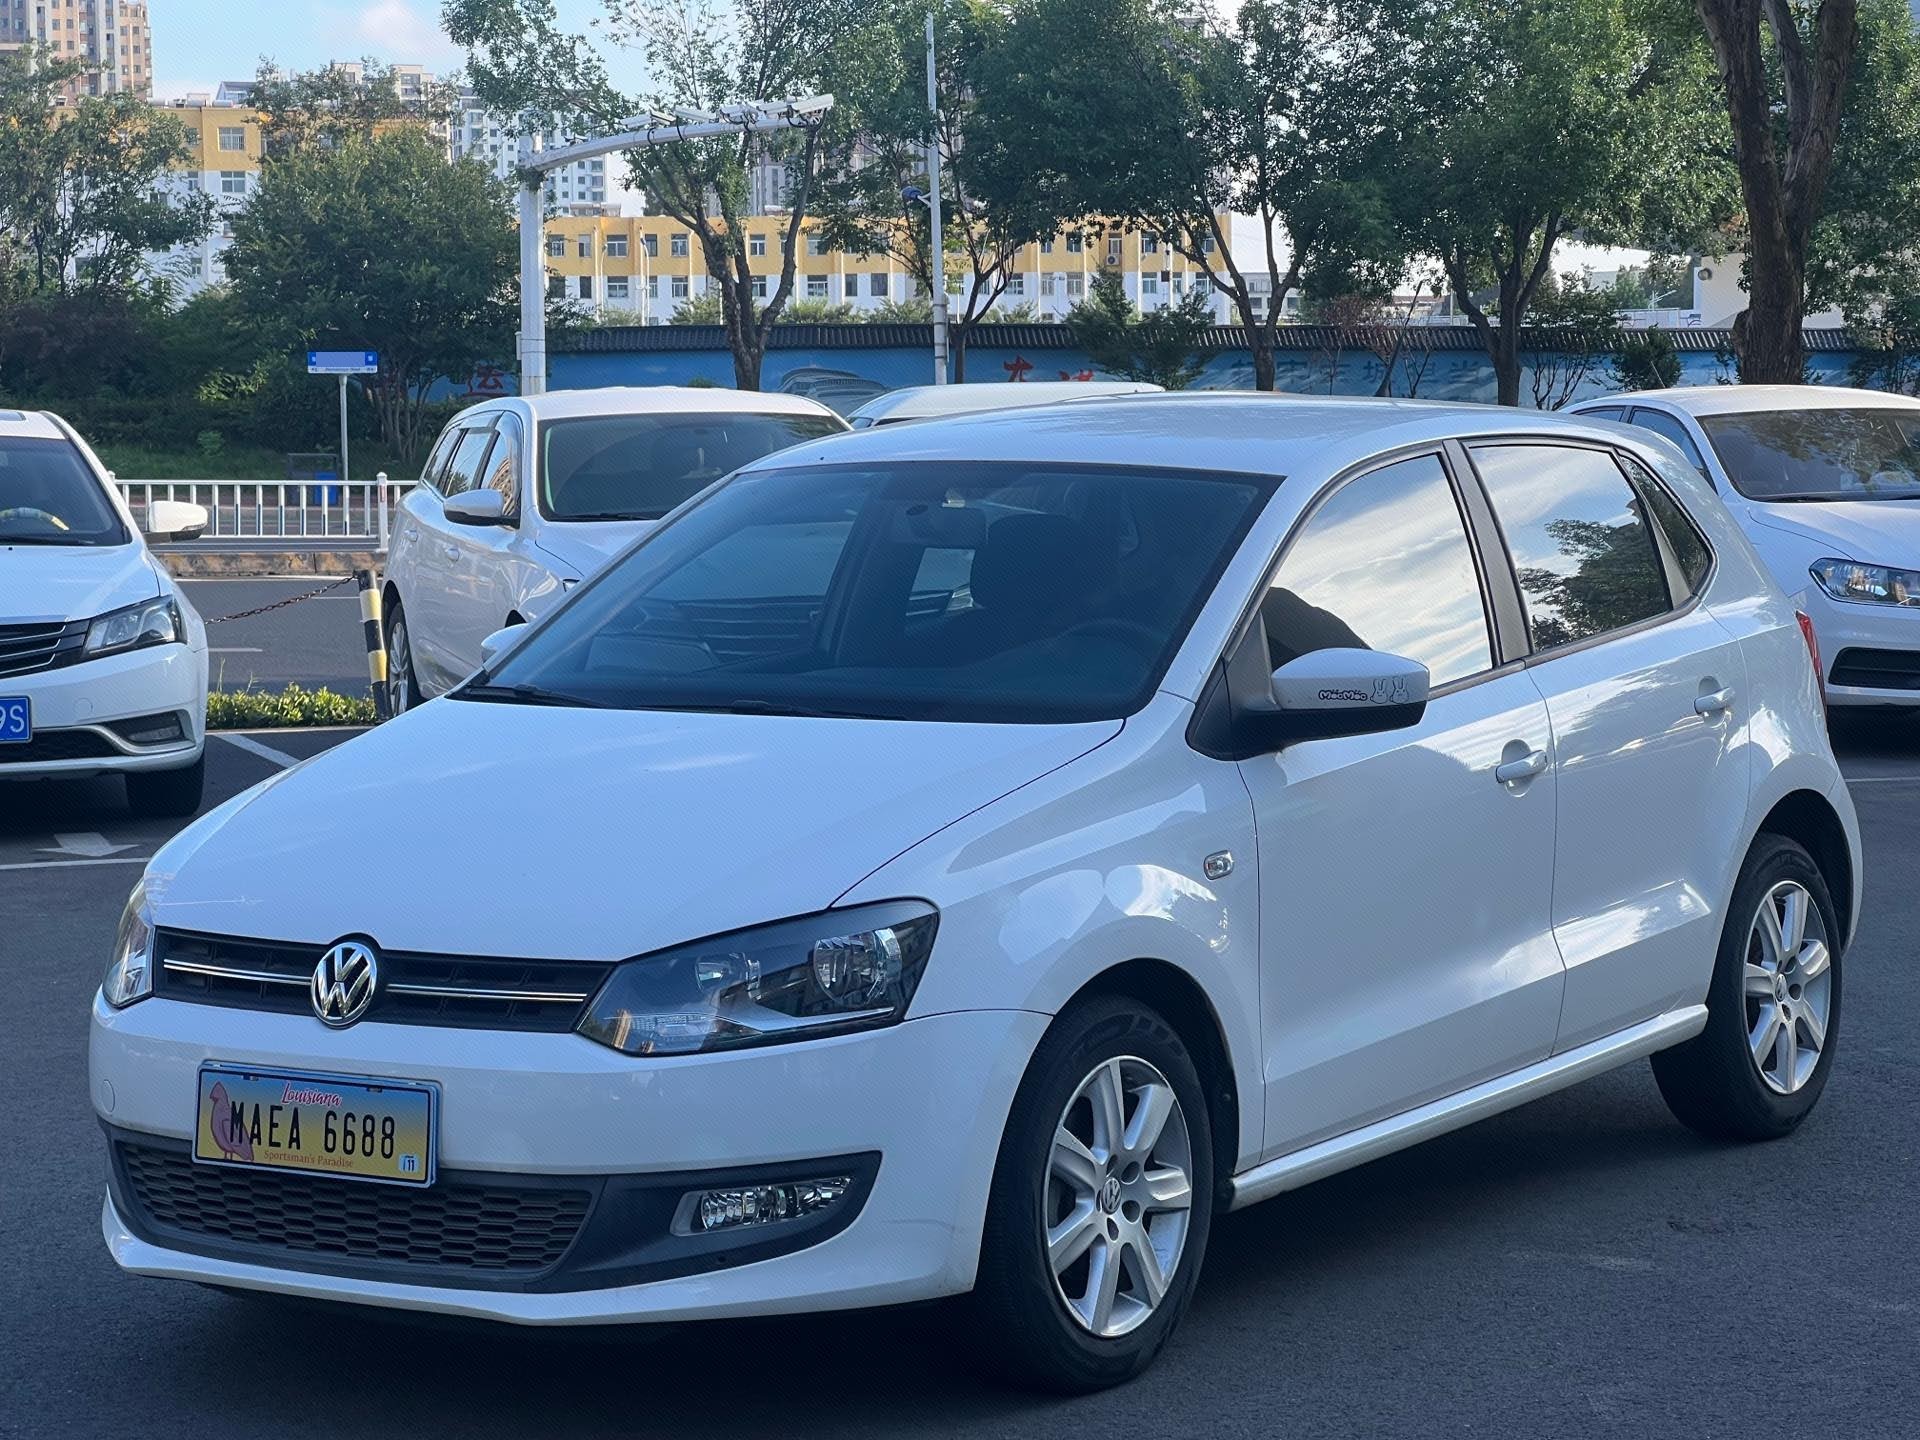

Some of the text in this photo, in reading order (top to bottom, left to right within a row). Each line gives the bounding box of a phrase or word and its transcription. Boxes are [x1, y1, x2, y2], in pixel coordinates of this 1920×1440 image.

[281, 1081, 343, 1107] Louisiana
[230, 1101, 395, 1159] MAEA 6688
[264, 1150, 353, 1168] Sportsman's Paradise
